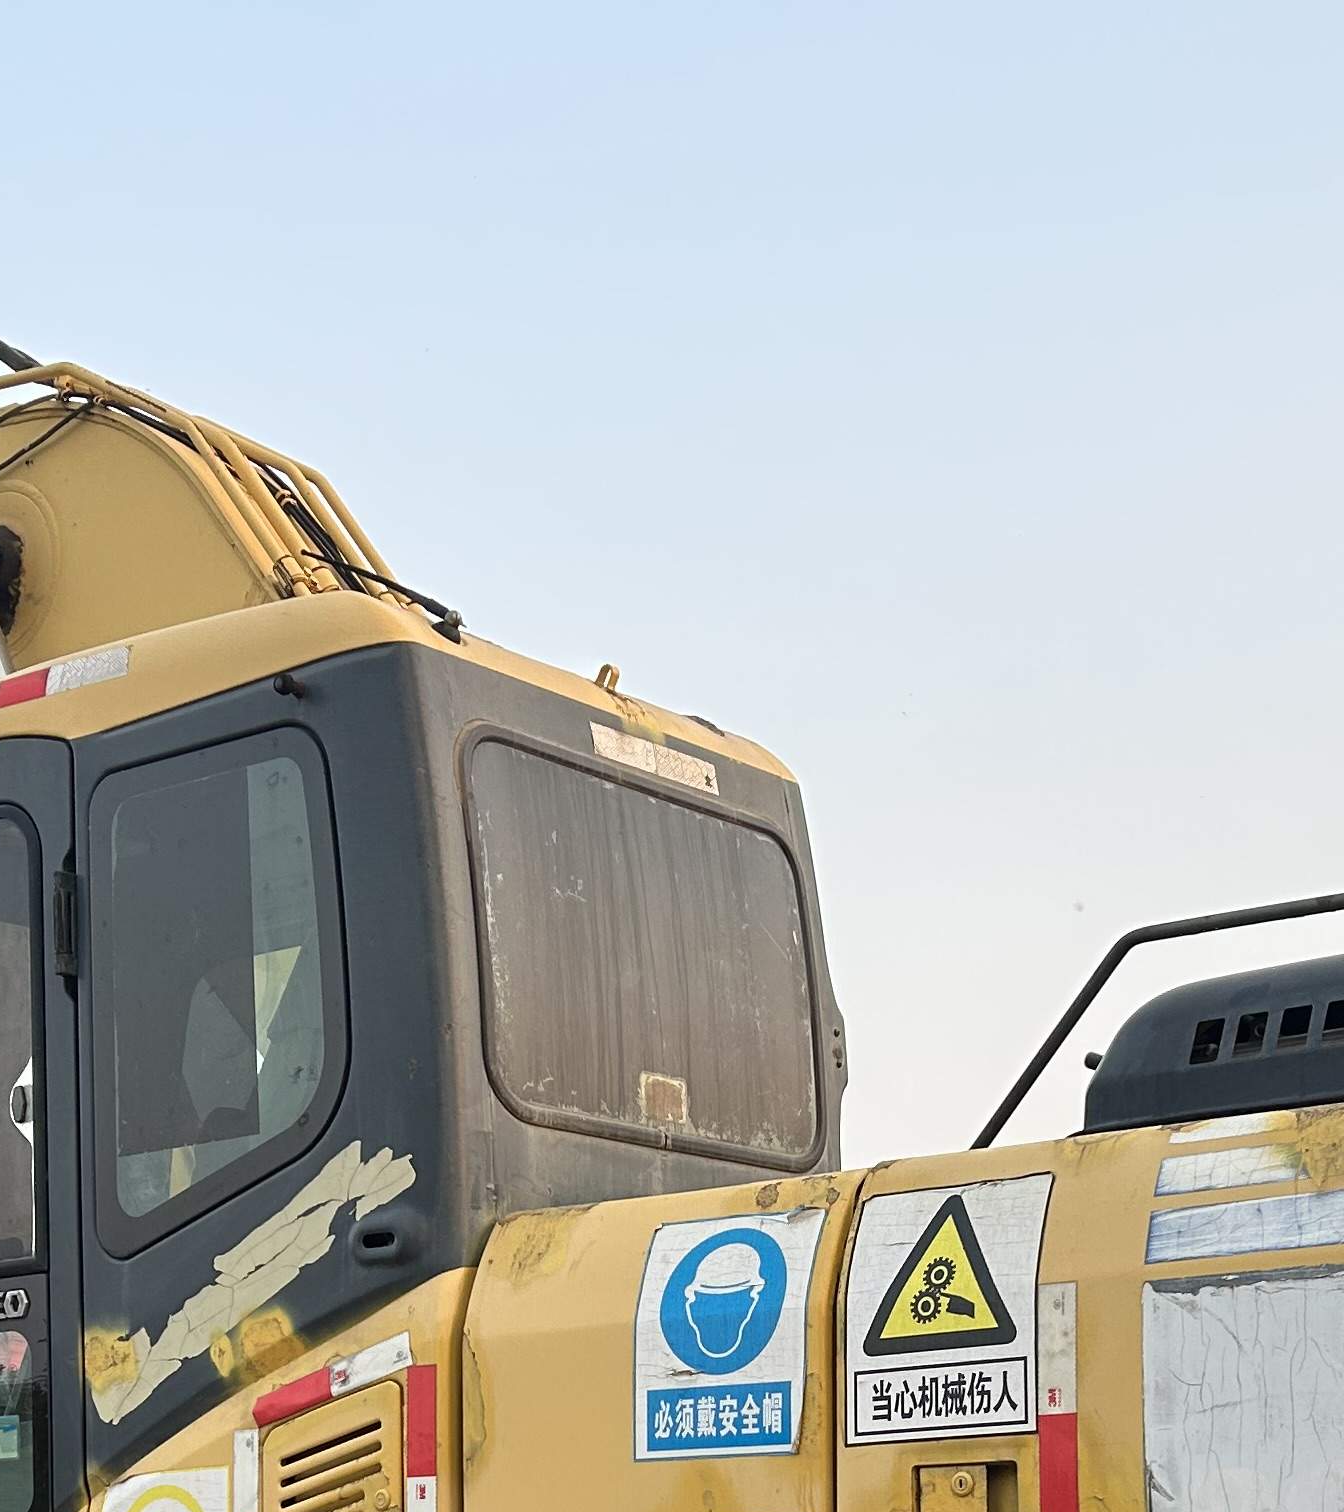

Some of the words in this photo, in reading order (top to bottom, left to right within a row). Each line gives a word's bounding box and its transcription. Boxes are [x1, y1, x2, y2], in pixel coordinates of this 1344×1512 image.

[654, 1398, 784, 1440] 必须戴安全帽
[871, 1372, 1019, 1423] 当心机械伤人
